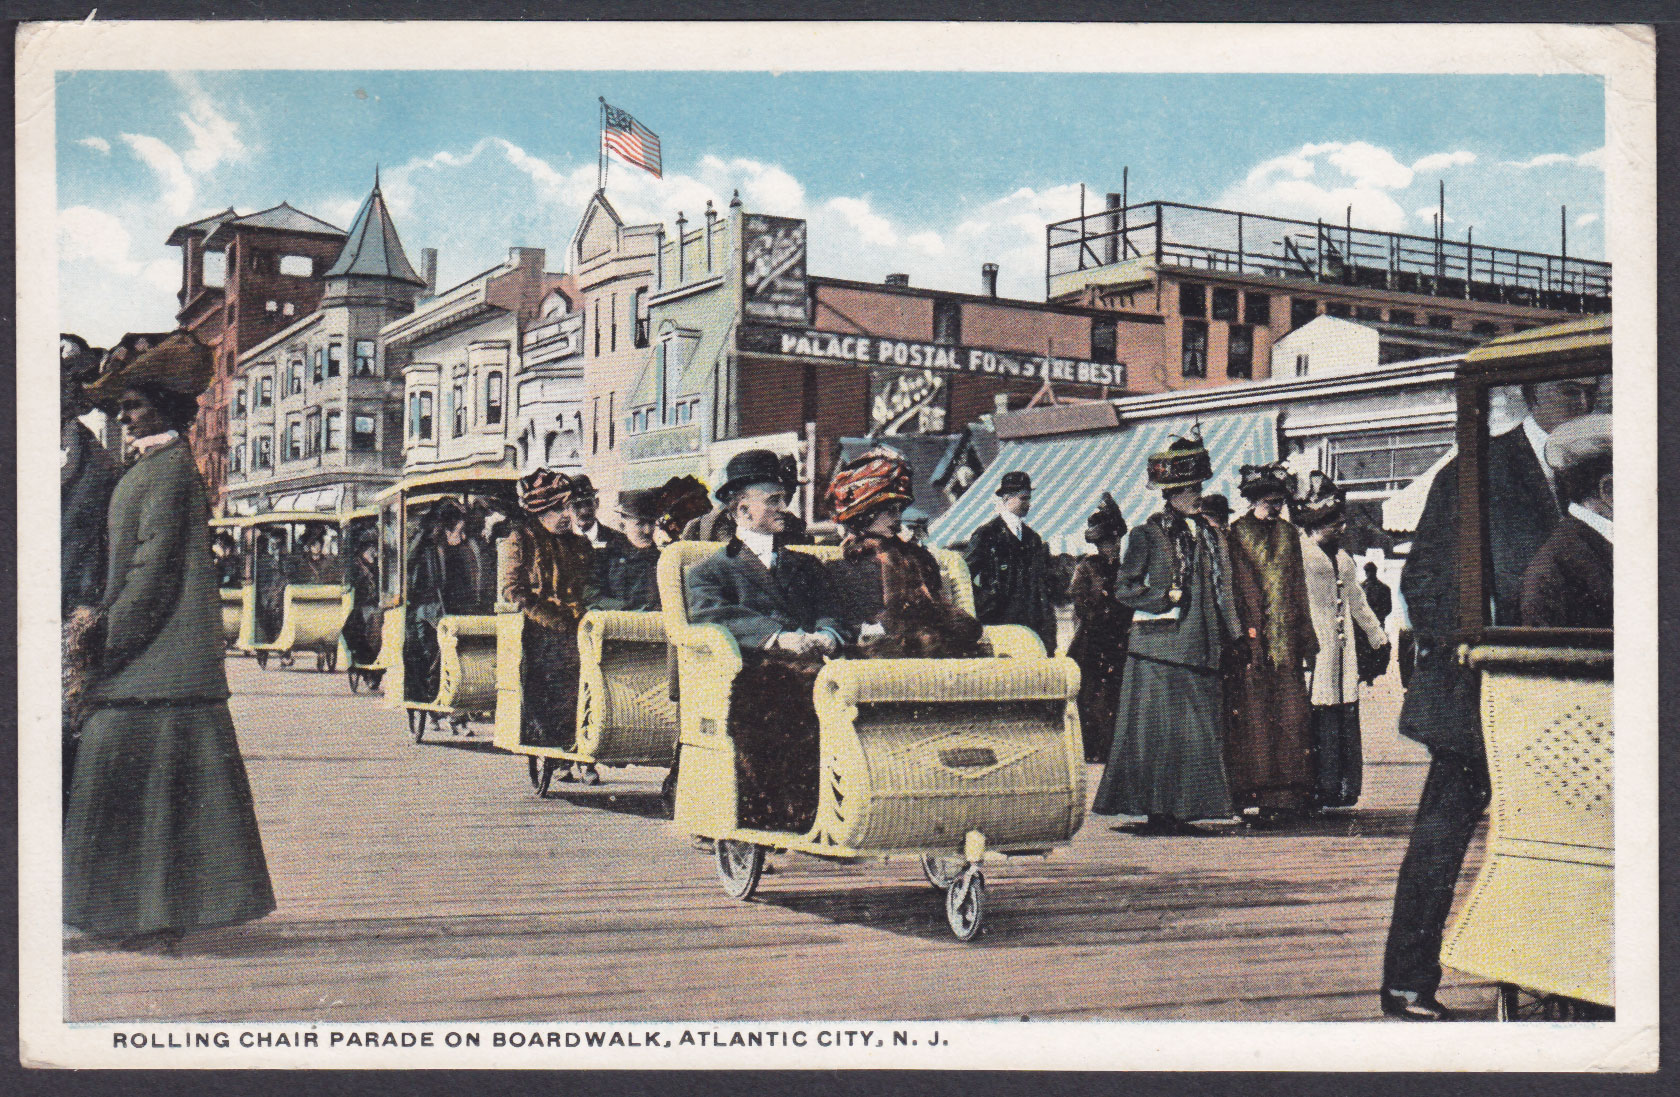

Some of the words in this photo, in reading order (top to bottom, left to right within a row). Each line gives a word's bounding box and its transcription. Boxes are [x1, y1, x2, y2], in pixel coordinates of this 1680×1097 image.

[781, 333, 870, 361] PALACE
[879, 340, 961, 369] POSTAL
[1077, 361, 1124, 385] BEST
[113, 1032, 230, 1049] ROLLING
[239, 1032, 319, 1048] CHAIR
[330, 1031, 434, 1048] PARADE
[444, 1031, 480, 1048] ON
[493, 1031, 671, 1048] BOARDWALK,
[679, 1030, 808, 1047] ATLANTIC
[817, 1030, 883, 1047] CITY,
[893, 1030, 918, 1047] N.
[928, 1031, 948, 1046] J.
